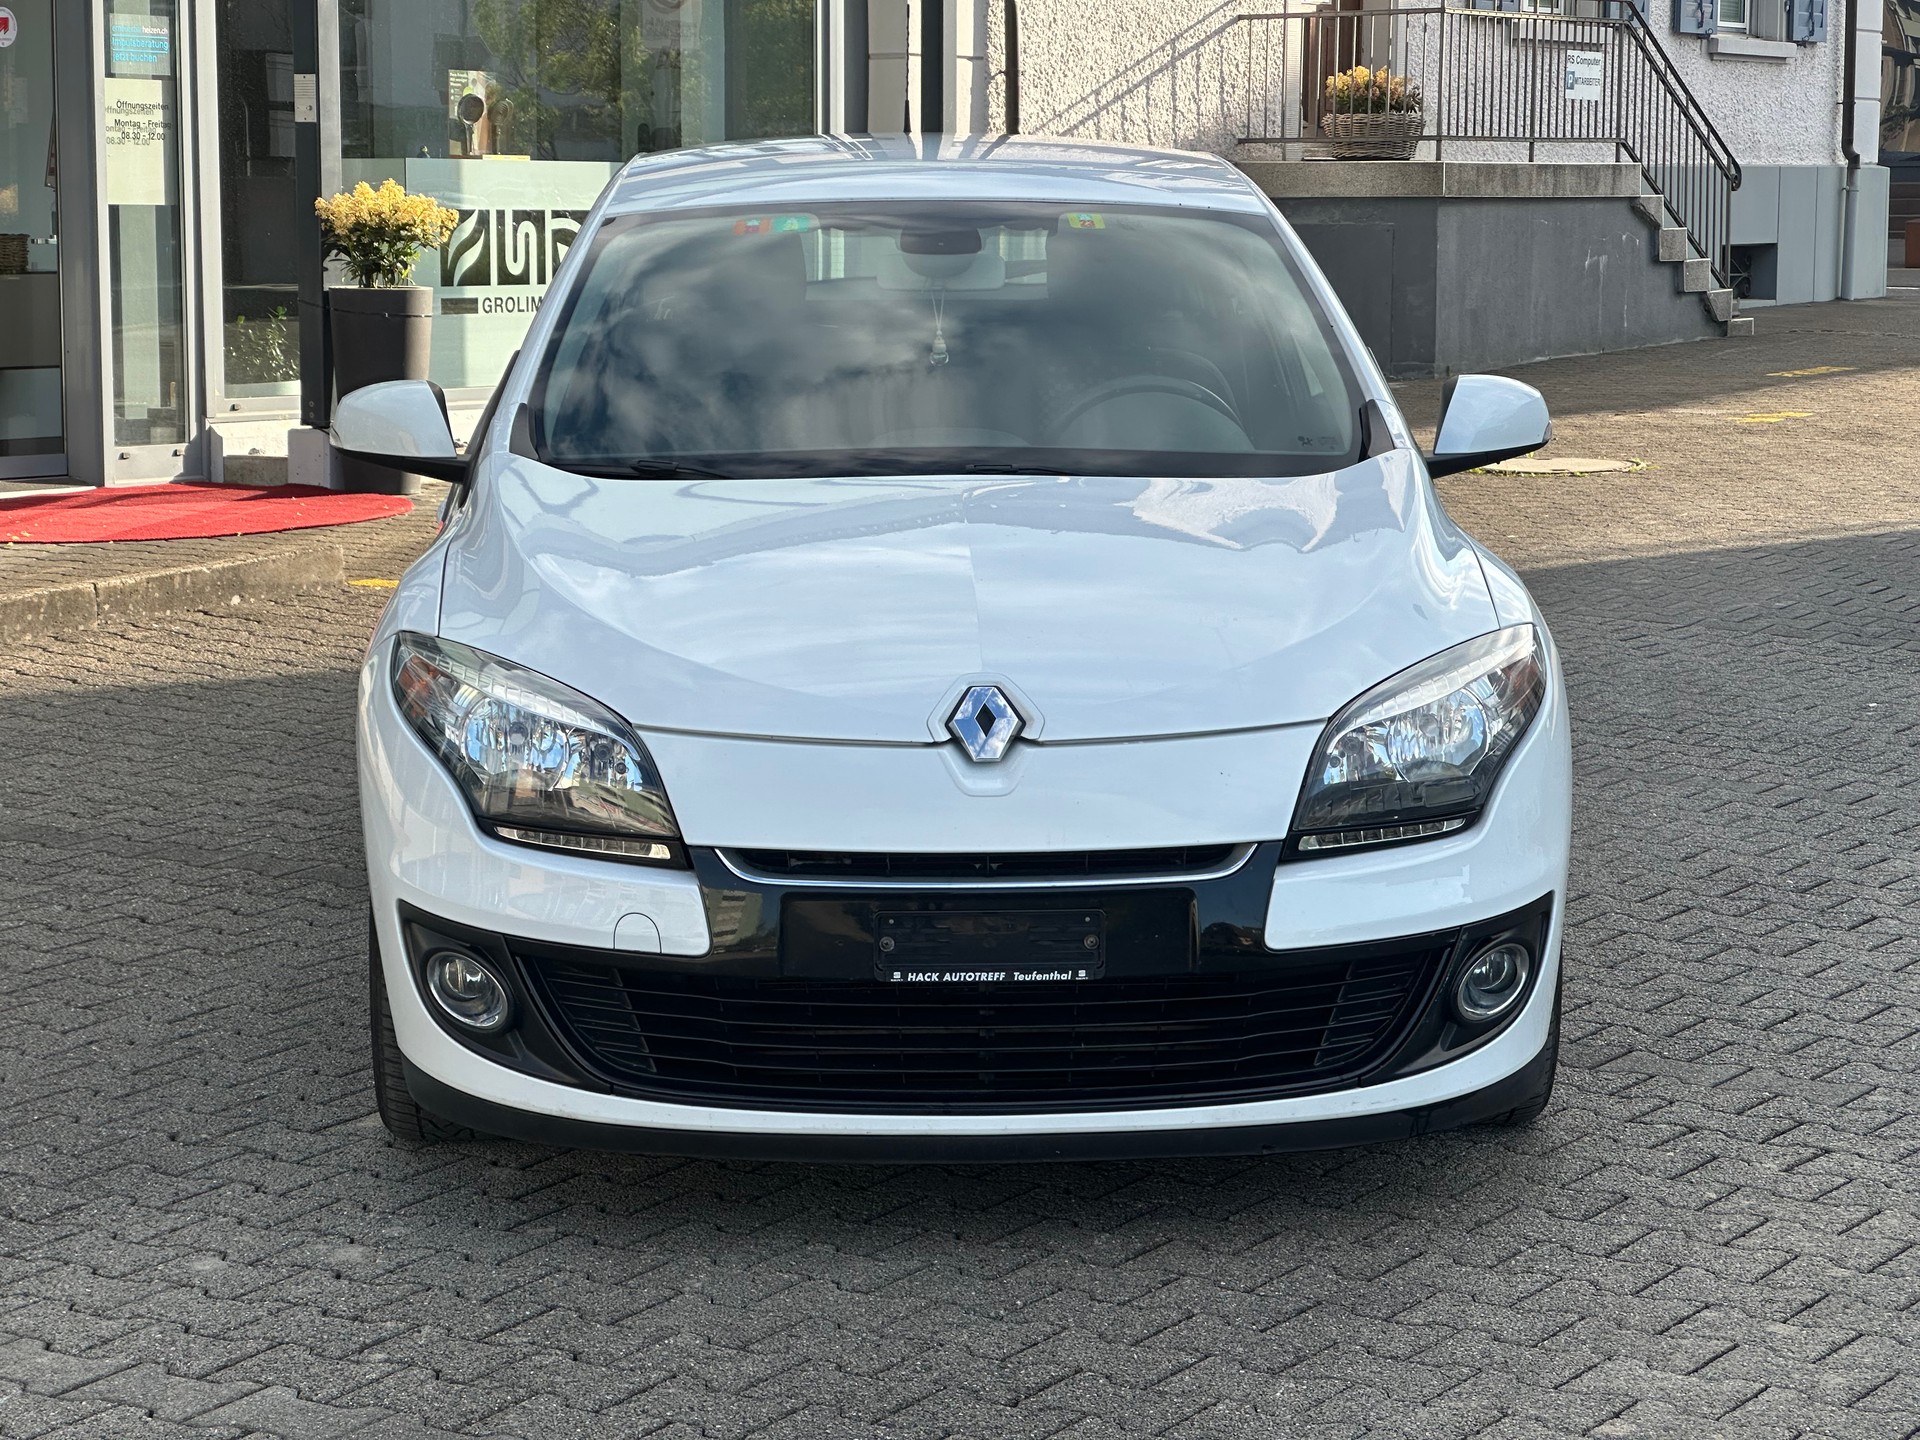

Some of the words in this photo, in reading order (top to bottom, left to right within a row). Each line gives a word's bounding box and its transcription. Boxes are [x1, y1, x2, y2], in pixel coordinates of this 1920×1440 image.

[112, 37, 168, 50] Impulsberatung
[130, 52, 157, 62] buchen
[1576, 55, 1601, 67] Computer
[1574, 77, 1600, 86] MITARBEITER
[116, 99, 169, 111] Öffnungszeiten
[114, 118, 141, 129] Montag
[147, 120, 172, 131] Freitag
[121, 131, 141, 140] 08.30
[147, 132, 166, 141] 12.00
[907, 972, 940, 982] HACK
[942, 972, 1006, 982] AUTOTREFF
[1013, 970, 1072, 981] Teufenthal
